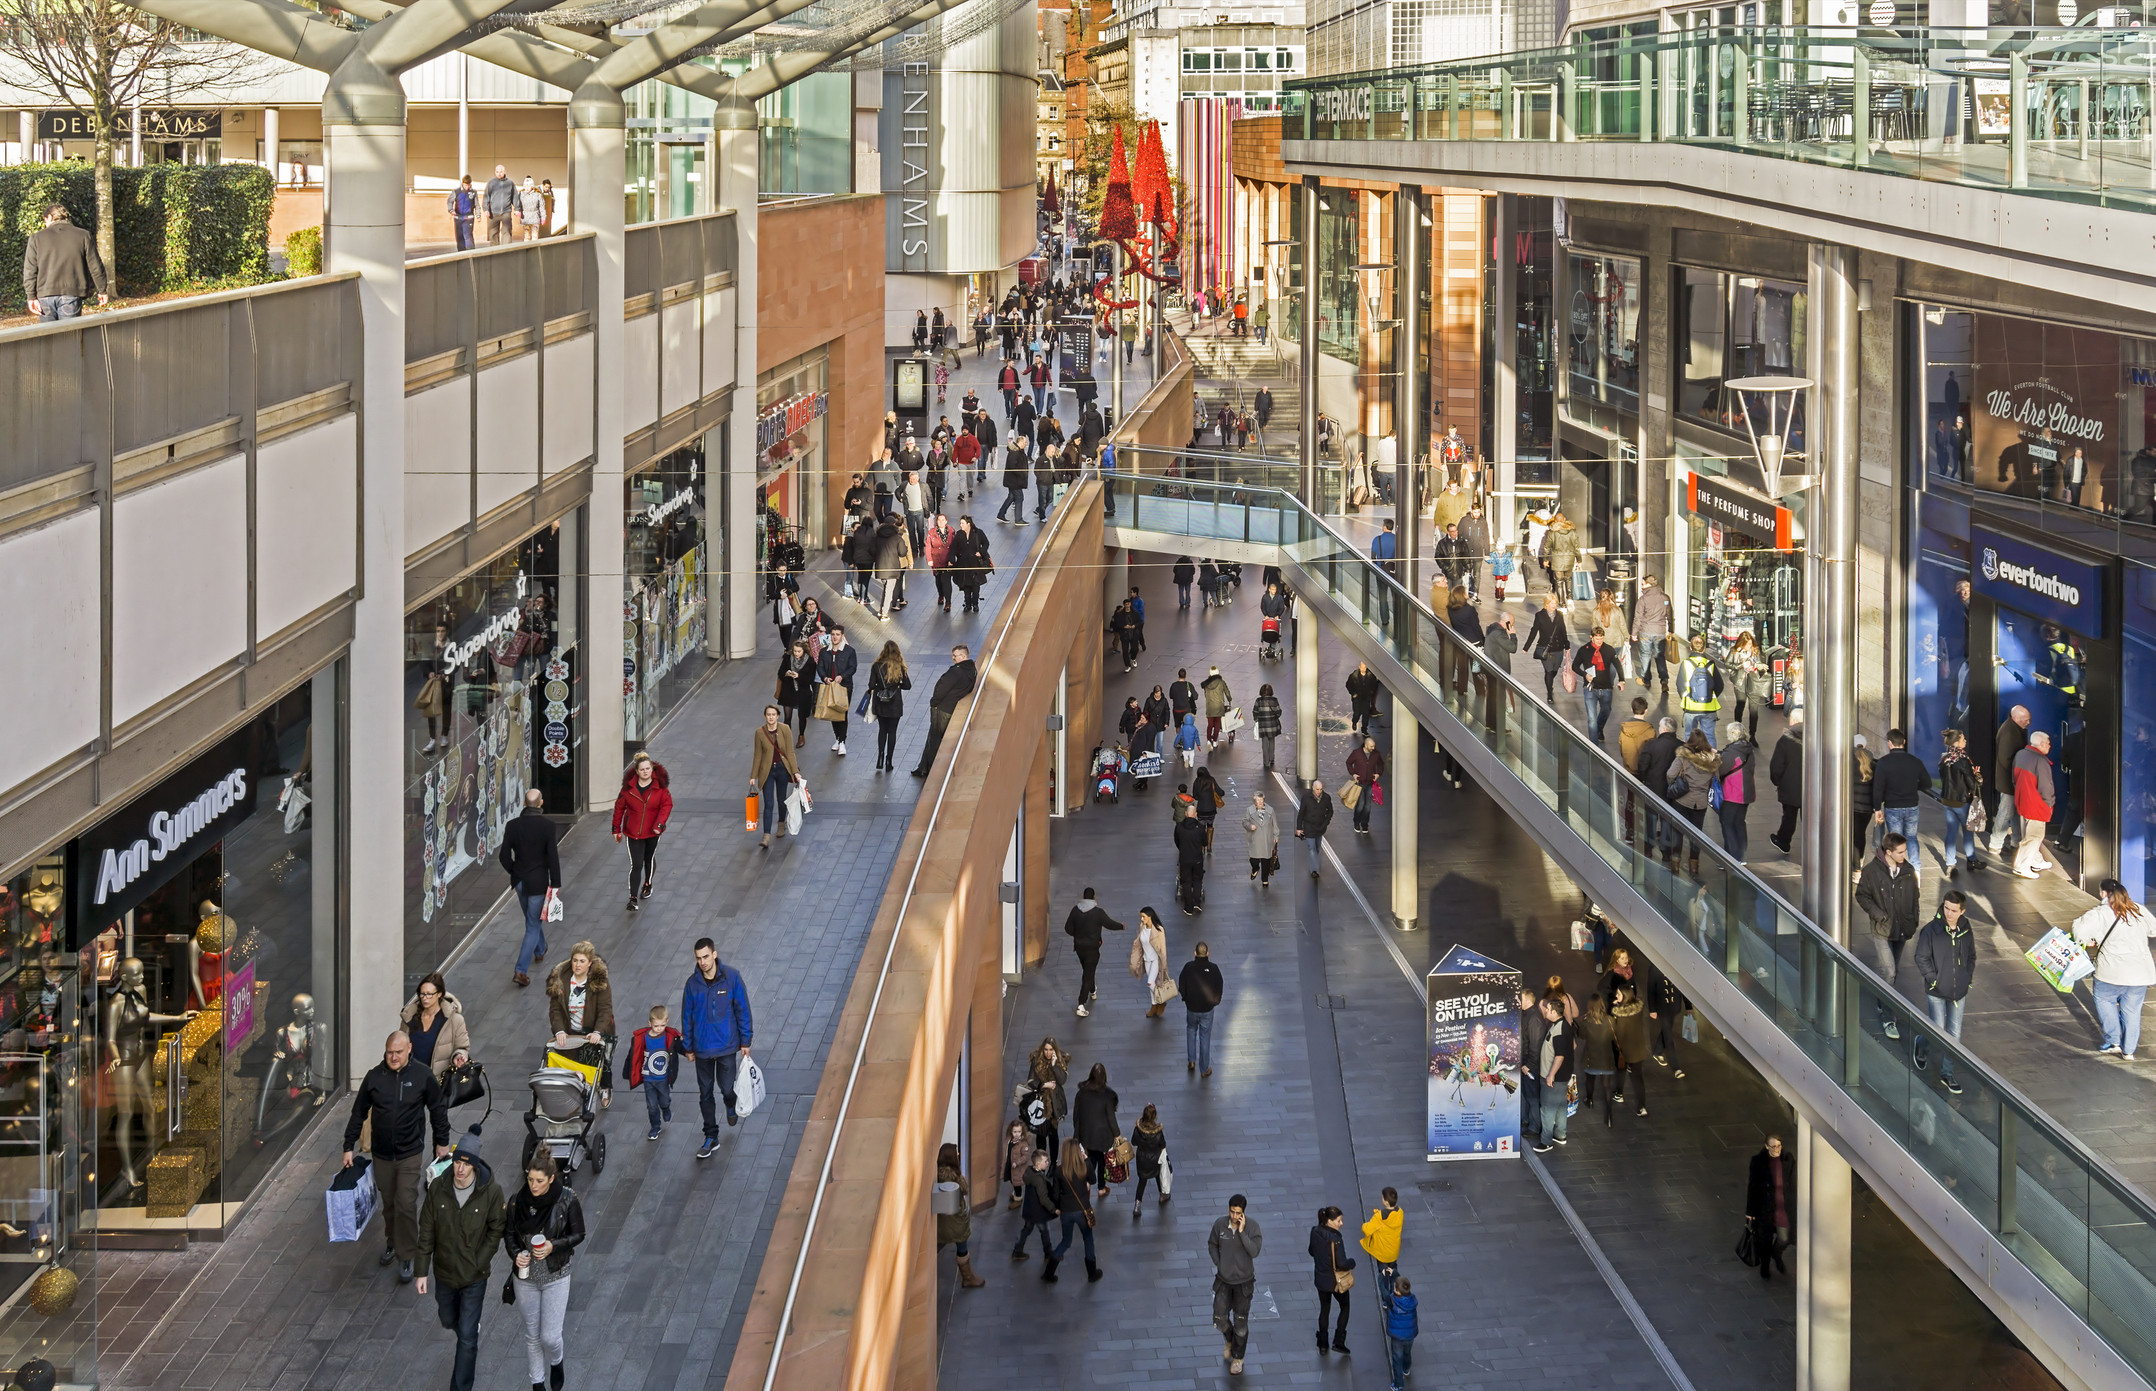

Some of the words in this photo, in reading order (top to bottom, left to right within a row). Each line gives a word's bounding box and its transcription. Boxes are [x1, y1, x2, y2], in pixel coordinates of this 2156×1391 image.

[1326, 87, 1370, 121] TERRACE
[2013, 381, 2035, 391] EVERTON
[2035, 381, 2060, 394] FOOTBALL
[2060, 390, 2074, 403] CLUB
[1986, 389, 2012, 419] We
[2013, 397, 2047, 428] Are
[2048, 402, 2105, 442] Chosen
[647, 486, 694, 527] Superdrug
[1697, 489, 1711, 505] THE
[1714, 496, 1749, 521] PERFUME
[1752, 512, 1776, 532] SHOP
[1999, 561, 2080, 605] evertontwo
[443, 606, 521, 675] Superdrug
[93, 838, 149, 905] Ann
[149, 767, 247, 862] Summers
[231, 982, 251, 1020] 30%
[1435, 997, 1461, 1012] SEE
[1462, 993, 1490, 1007] YOU
[1435, 1010, 1456, 1023] ON
[1456, 1005, 1483, 1020] THE
[1483, 1001, 1508, 1016] ICE.
